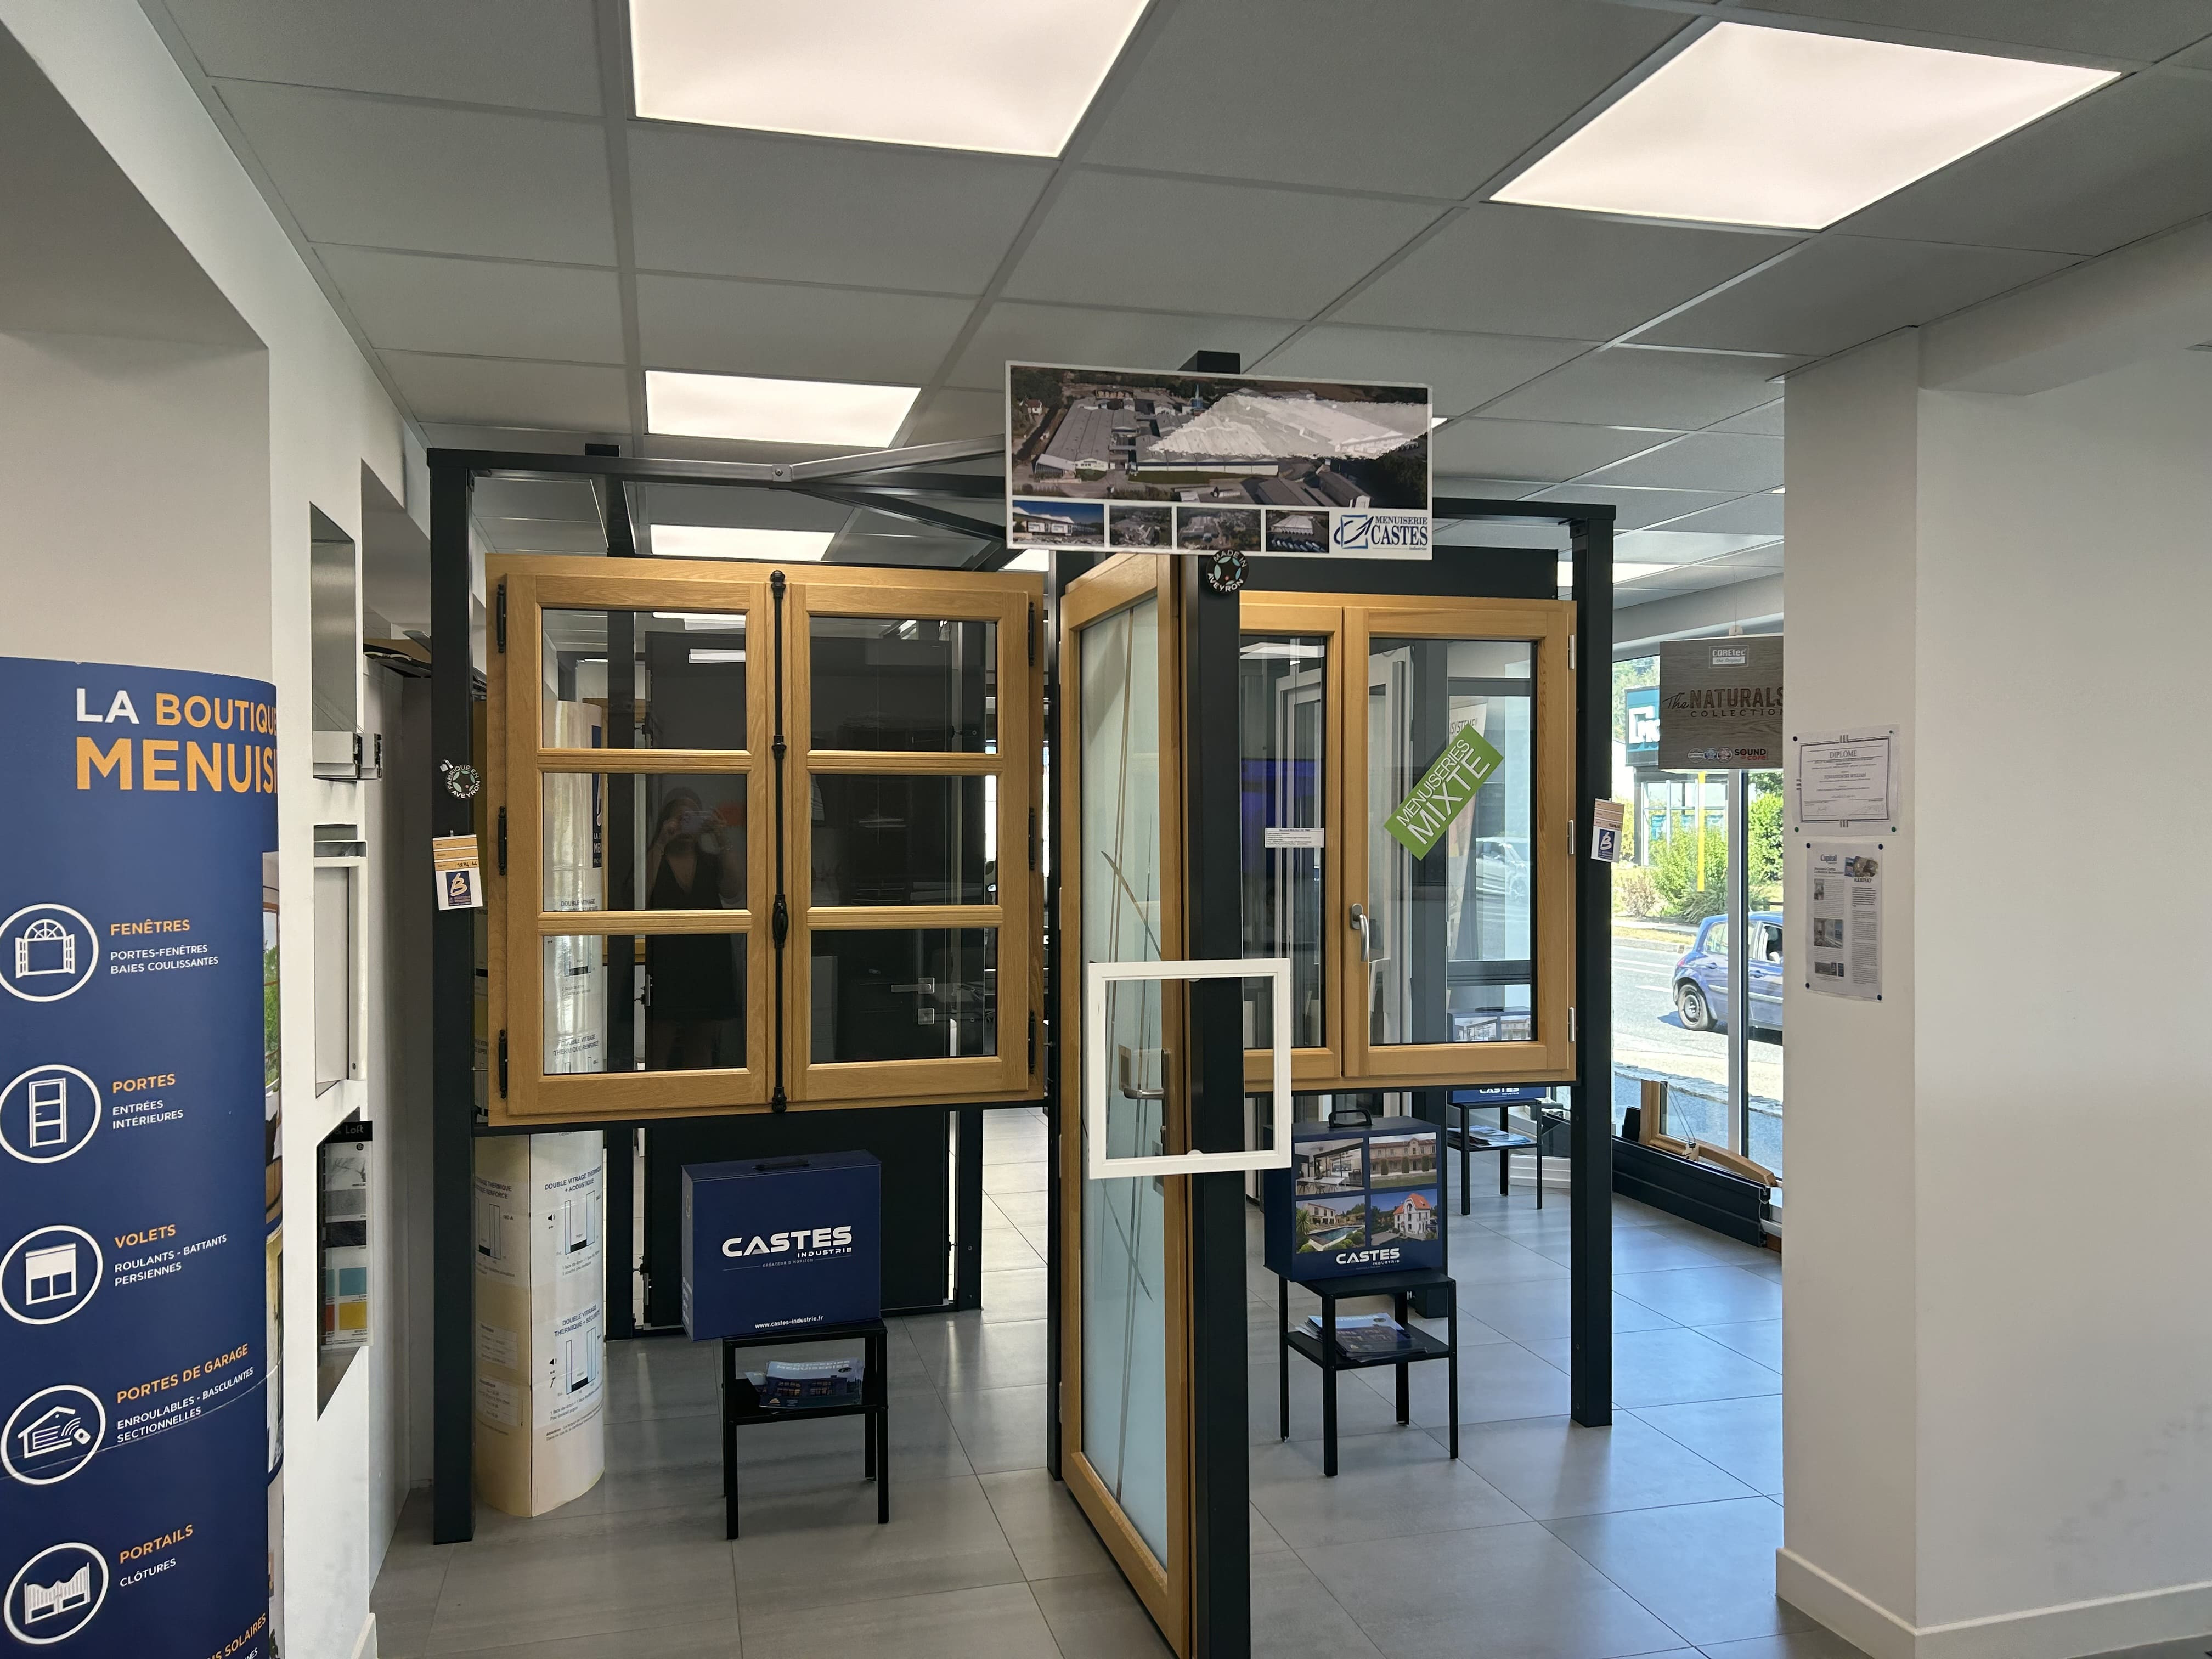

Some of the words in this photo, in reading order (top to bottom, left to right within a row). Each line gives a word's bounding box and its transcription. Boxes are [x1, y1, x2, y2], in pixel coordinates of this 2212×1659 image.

[1375, 516, 1428, 525] MENUISERIE
[1371, 524, 1428, 546] CASTES
[1213, 550, 1239, 562] MADE
[1239, 557, 1247, 568] IN
[1207, 573, 1243, 592] AVEYRON
[76, 687, 139, 724] LA
[1662, 692, 1690, 710] The
[1690, 686, 1782, 709] NATURALS
[1830, 750, 1858, 759] DIPLOME
[447, 765, 471, 789] FABRIQUÉ
[471, 769, 479, 778] EN
[1396, 739, 1470, 826] MENUISERIES
[451, 780, 481, 799] AVEYRON
[1407, 748, 1491, 845] MIXTE
[110, 918, 190, 936] FENÊTRES
[110, 944, 208, 961] PORTES-FENÊTRES
[110, 962, 145, 974] BAIES
[147, 956, 218, 972] COULISSANTES
[112, 1073, 176, 1093] PORTES
[112, 1099, 163, 1115] ENTRÉES
[112, 1109, 184, 1130] INTÉRIEURES
[345, 1124, 364, 1135] Loft
[544, 1180, 567, 1190] DOUBLE
[567, 1173, 586, 1184] VITRAGE
[569, 1178, 594, 1192] ACOUSTIQUE
[114, 1224, 176, 1249] VOLETS
[721, 1226, 853, 1257] CASTES
[114, 1250, 174, 1272] ROULANTS
[183, 1234, 227, 1256] BATTANTS
[797, 1247, 853, 1258] INDUSTRIE
[1336, 1248, 1400, 1265] CASTES
[114, 1262, 182, 1286] PERSIENNES
[562, 1313, 582, 1326] DOUBLE
[755, 1315, 824, 1329] www.castes-industrie.fr
[117, 1373, 179, 1403] PORTES
[183, 1365, 201, 1383] DE
[204, 1342, 249, 1374] GARAGE
[117, 1396, 195, 1430] ENROULABLES
[202, 1367, 254, 1401] BASCULANTES
[117, 1406, 202, 1443] SECTIONNELLES
[119, 1524, 194, 1564] PORTAILS
[119, 1558, 177, 1588] CLÔTURES
[225, 1612, 266, 1657] SOLAIRES
